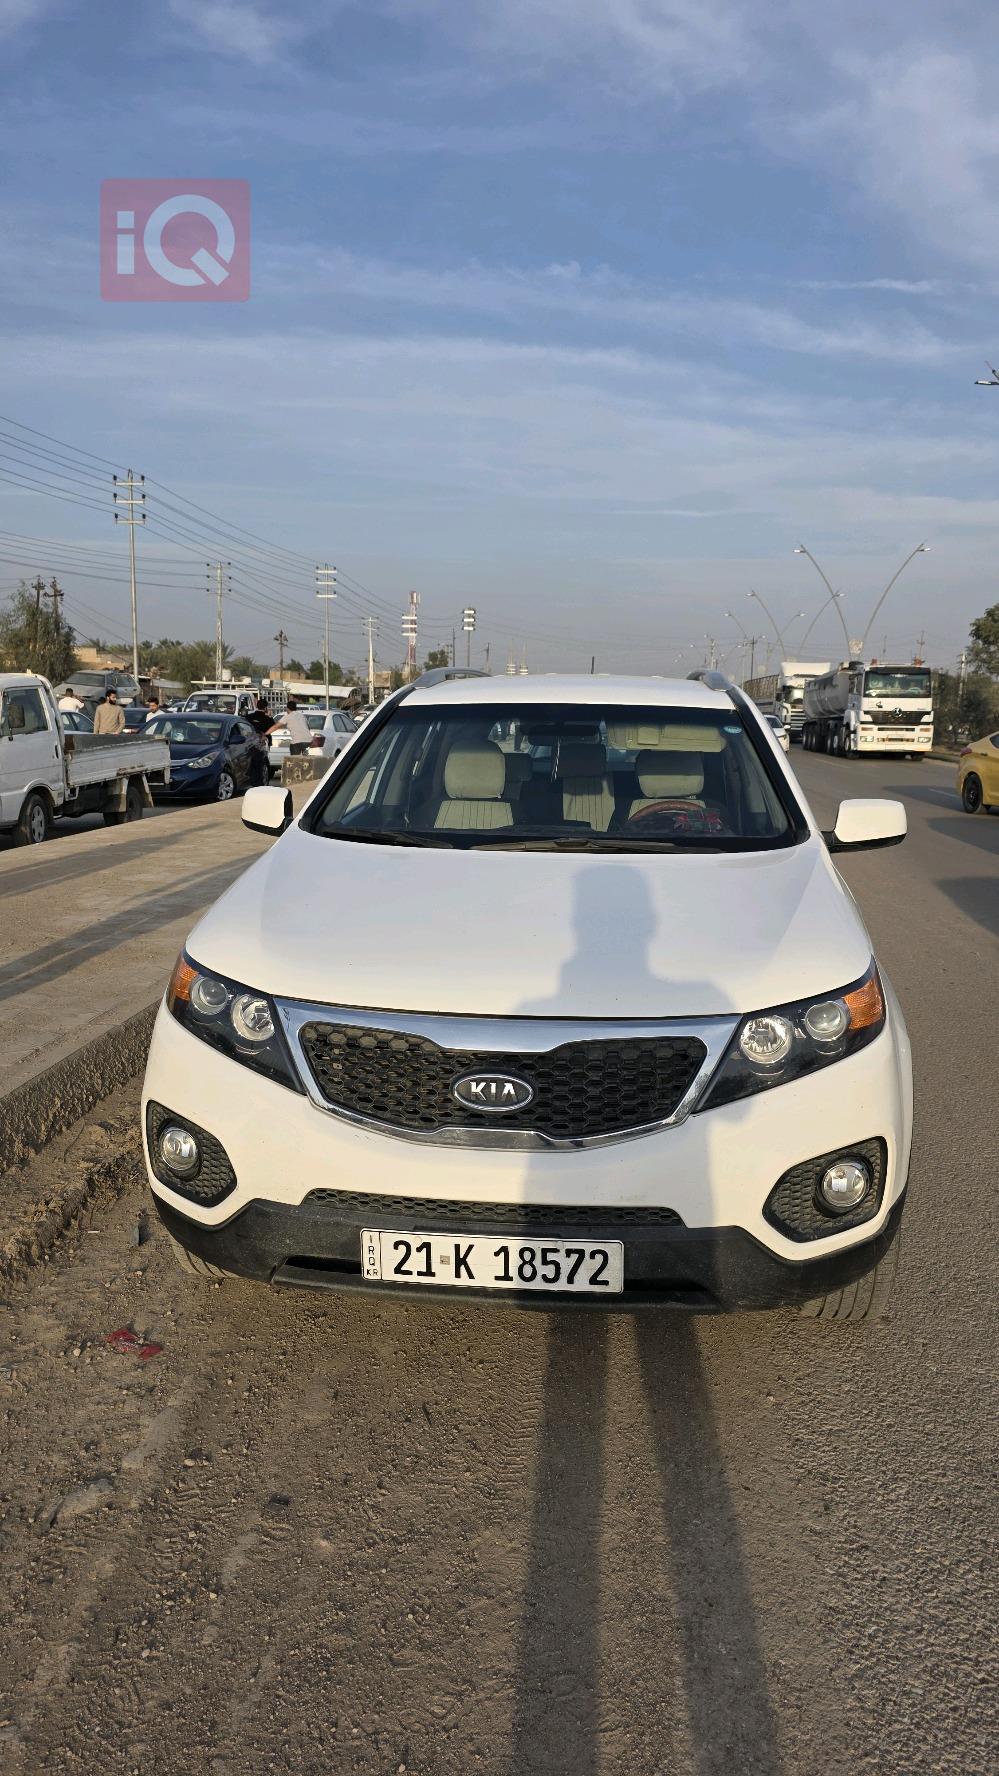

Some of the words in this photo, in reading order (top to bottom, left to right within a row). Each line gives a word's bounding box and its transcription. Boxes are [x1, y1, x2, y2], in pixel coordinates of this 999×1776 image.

[470, 1081, 518, 1101] KIA
[366, 1268, 379, 1277] KR
[393, 1239, 436, 1277] 21
[453, 1243, 476, 1280] K
[493, 1245, 610, 1286] 18572
